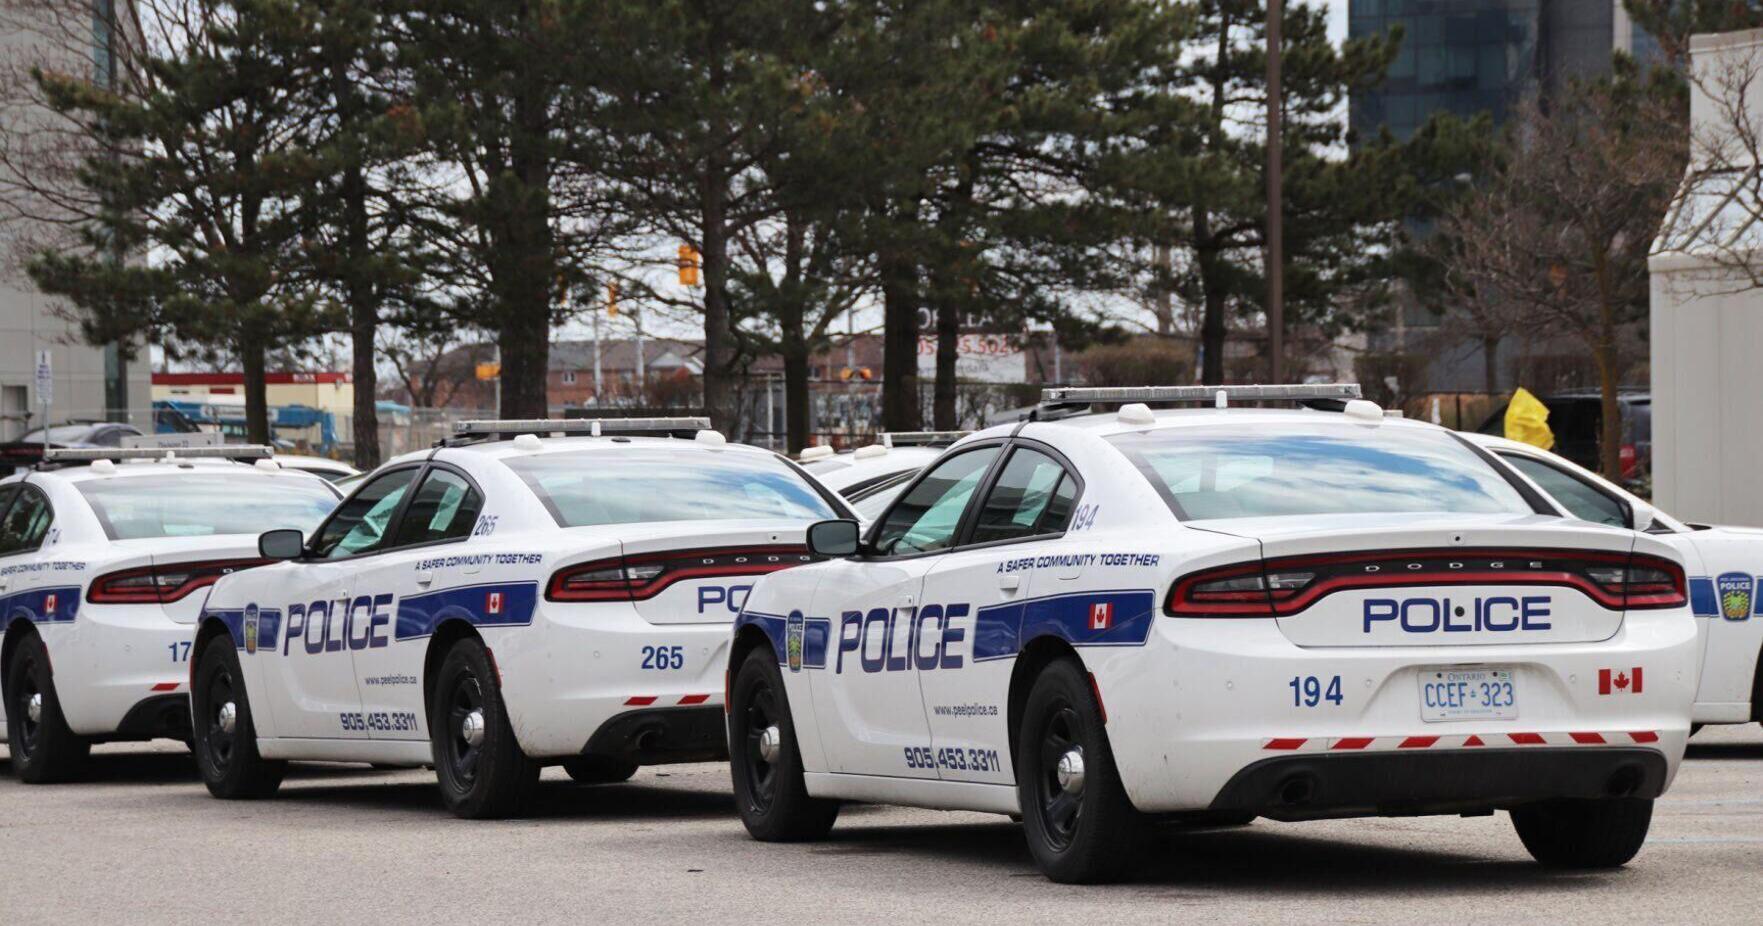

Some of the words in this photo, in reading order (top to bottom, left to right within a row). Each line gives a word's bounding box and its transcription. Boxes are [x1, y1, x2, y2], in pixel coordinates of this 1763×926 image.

[474, 515, 499, 536] 265
[1071, 504, 1099, 531] 194
[415, 560, 421, 571] A
[422, 558, 445, 570] SAFER
[446, 554, 493, 567] COMMUNITY
[495, 553, 542, 564] TOGETHER
[703, 555, 810, 565] DODG
[997, 562, 1004, 574] A
[1005, 558, 1034, 573] SAFER
[1036, 555, 1096, 569] COMMUNITY
[1099, 554, 1160, 567] TOGETHER
[1365, 561, 1542, 572] DODGE
[1720, 582, 1751, 590] POLICE
[284, 593, 393, 656] POLICE
[1363, 596, 1552, 633] POLICE
[836, 603, 970, 674] POLICE
[168, 641, 192, 662] 17
[641, 646, 683, 670] 265
[365, 673, 417, 687] www.peelpolice.ca
[1289, 676, 1343, 707] 194
[1425, 682, 1467, 707] CCEF
[1480, 682, 1513, 707] 323
[933, 703, 998, 718] www.peelpolice.ca
[340, 713, 417, 731] 905.453.3311
[904, 747, 1000, 772] 905.453.3311
